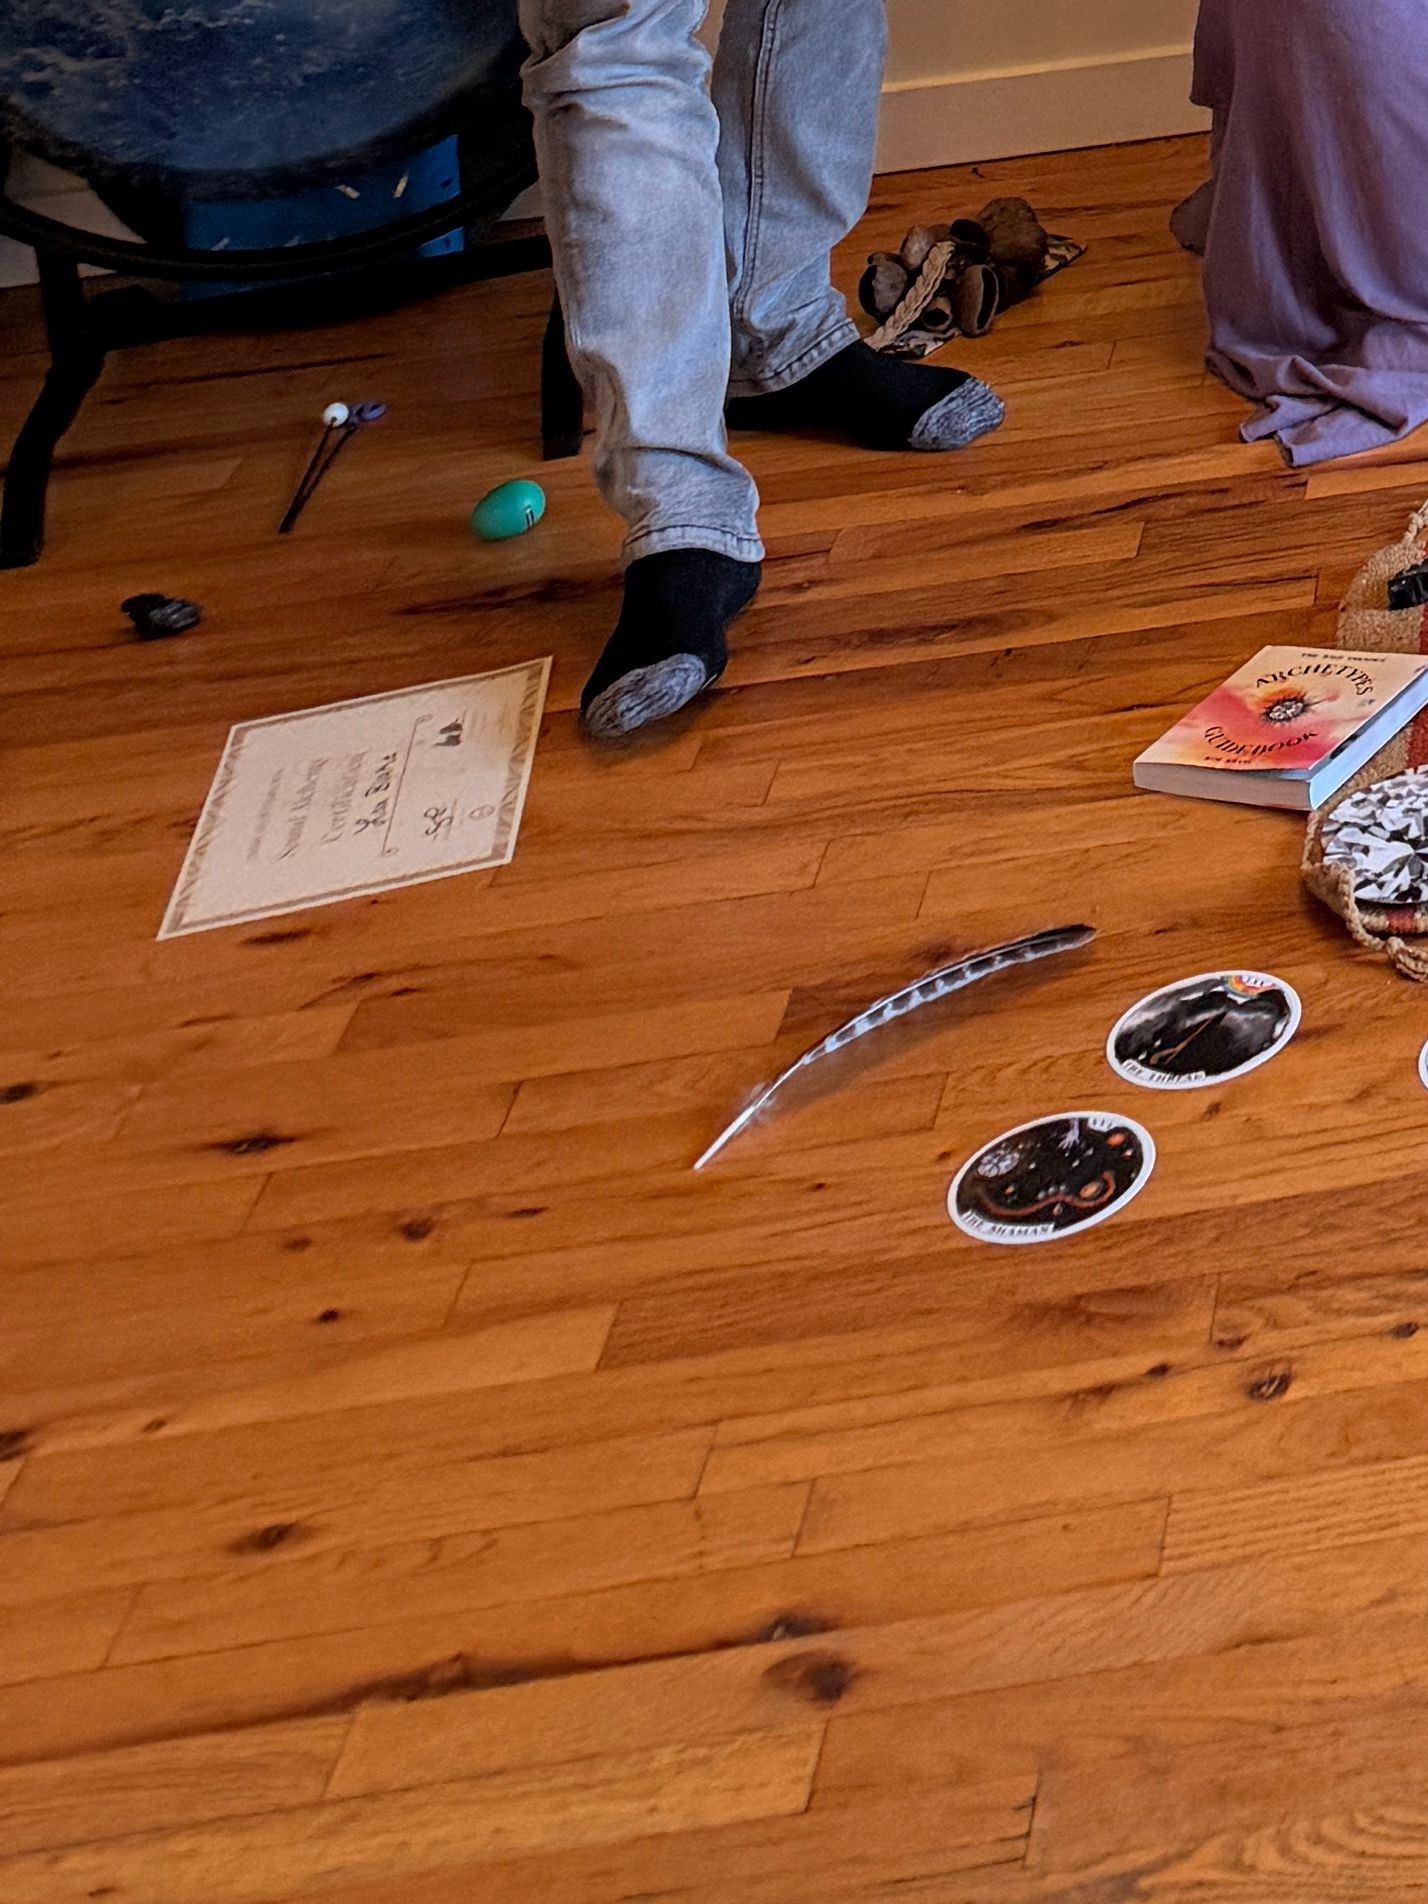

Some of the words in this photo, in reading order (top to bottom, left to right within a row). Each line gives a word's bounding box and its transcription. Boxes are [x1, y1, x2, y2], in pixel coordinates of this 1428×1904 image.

[1256, 662, 1375, 696] ARCHETYPES
[1204, 725, 1318, 756] GUIDEBOOK
[991, 1224, 1049, 1236] SHAMAN
